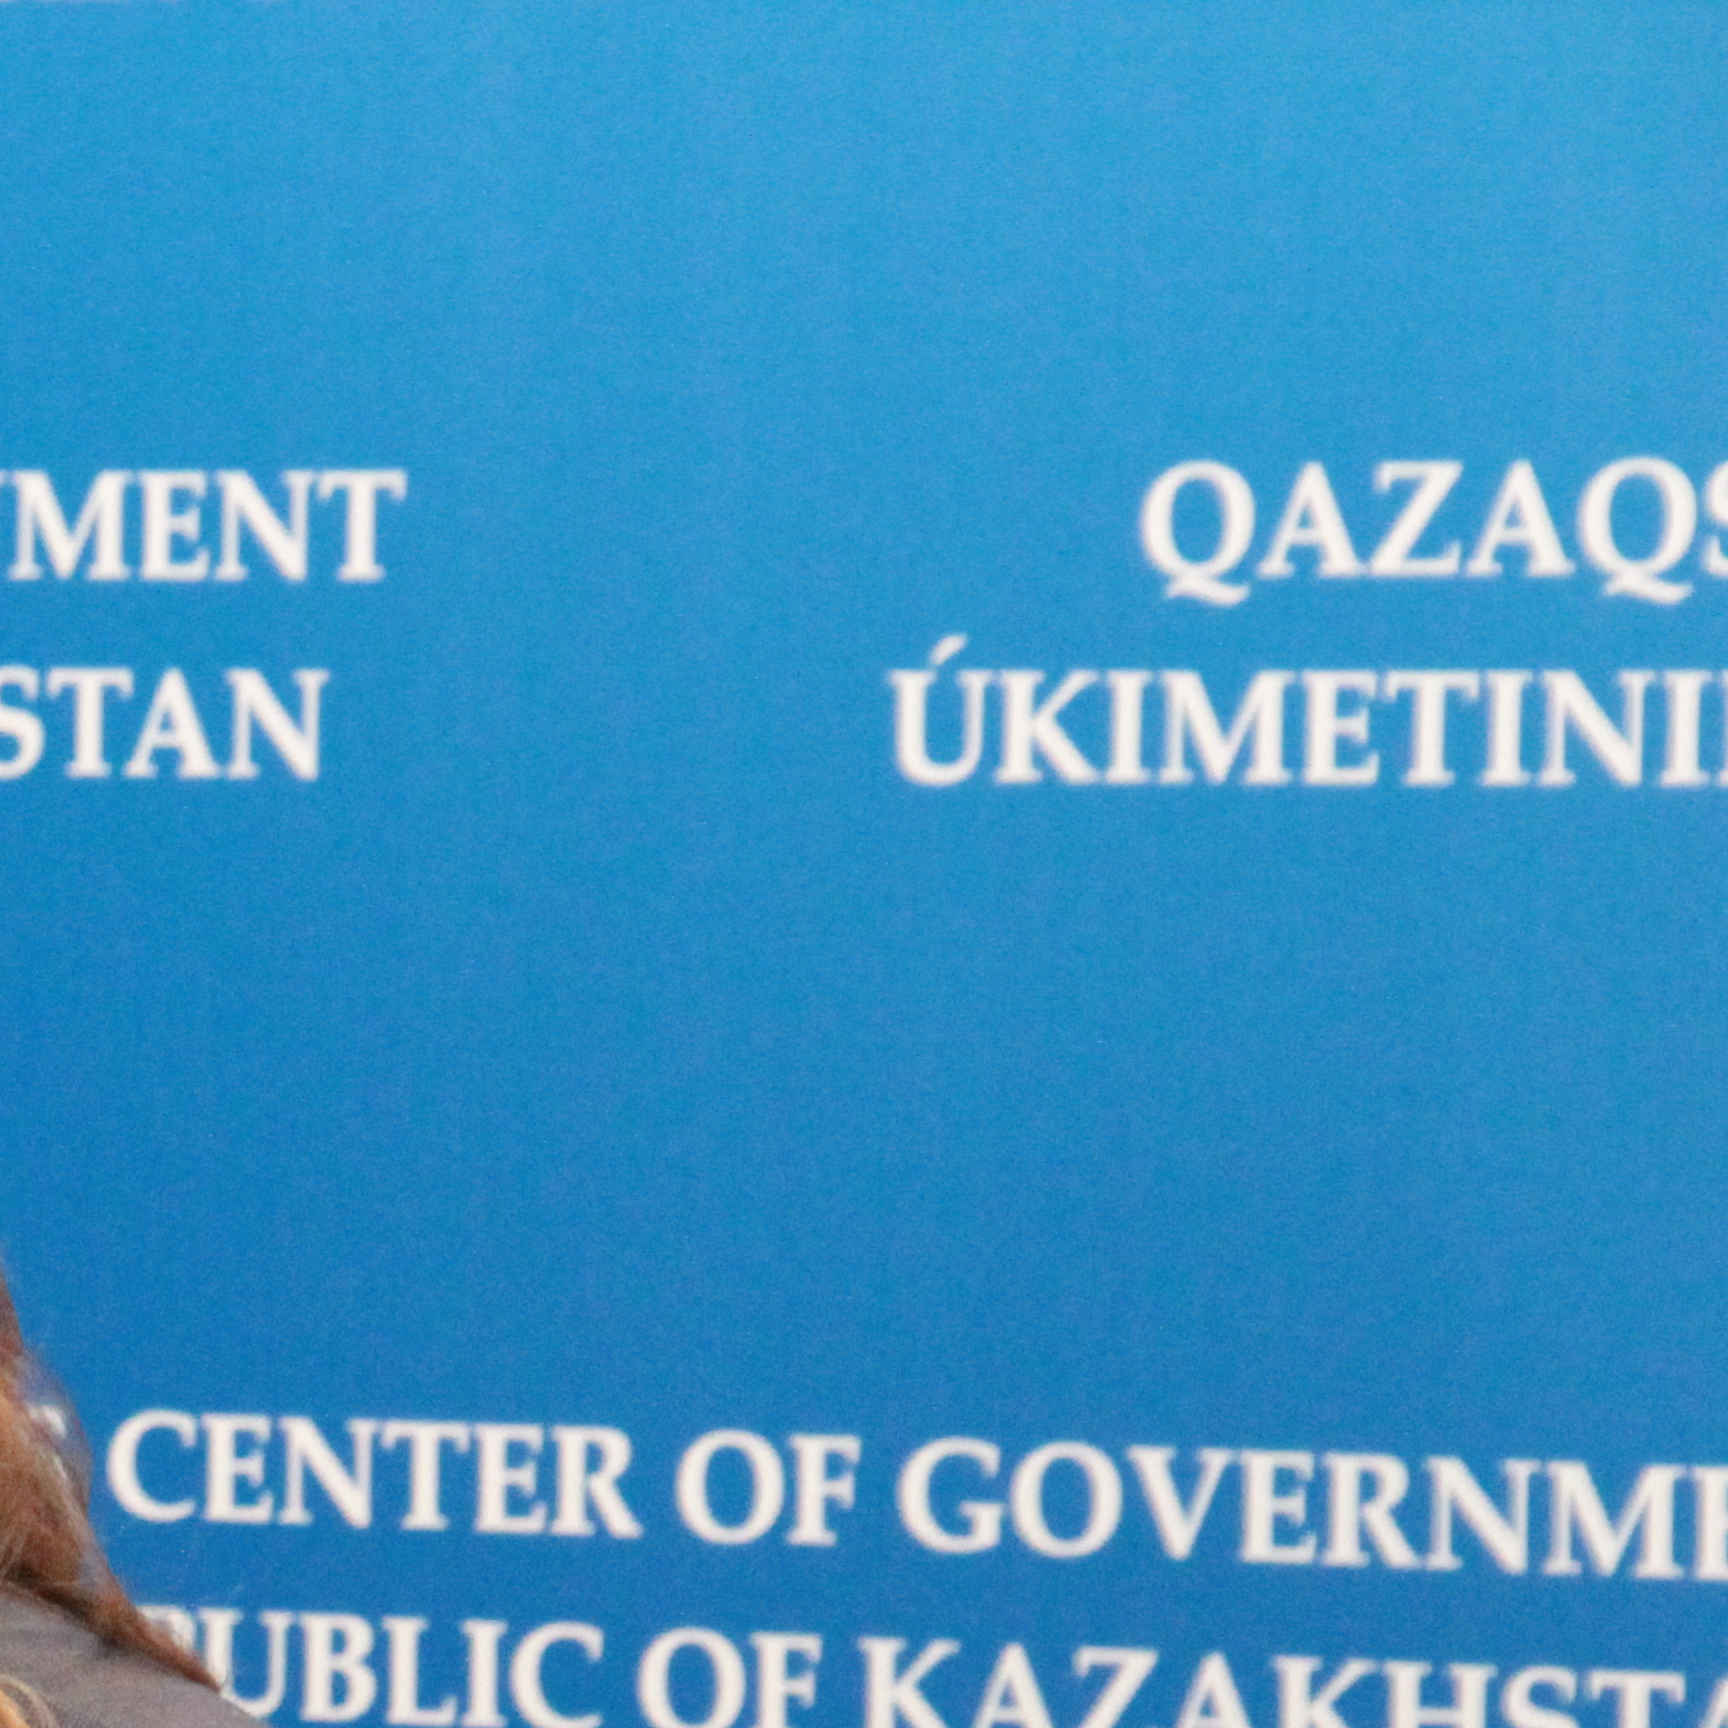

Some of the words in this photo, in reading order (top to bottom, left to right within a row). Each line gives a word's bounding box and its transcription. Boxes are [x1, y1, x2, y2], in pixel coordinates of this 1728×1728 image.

[887, 632, 1728, 789] ÚKIMETINI
[105, 1408, 643, 1540] CENTER
[674, 1428, 862, 1548] OF
